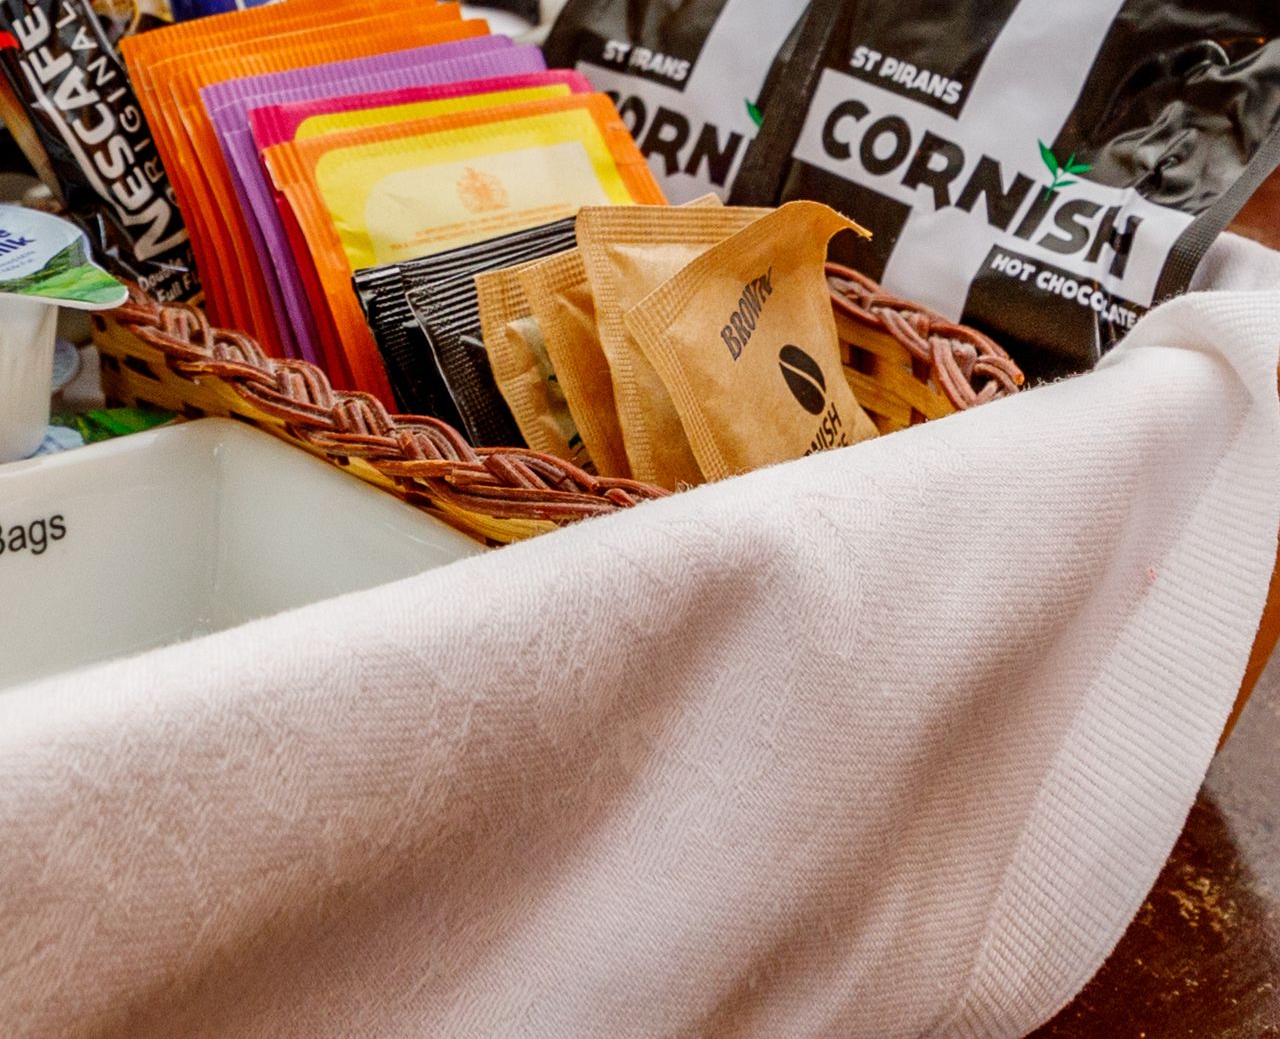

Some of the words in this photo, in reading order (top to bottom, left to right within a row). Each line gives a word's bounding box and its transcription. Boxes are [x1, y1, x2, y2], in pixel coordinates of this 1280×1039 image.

[602, 39, 631, 63] ST
[849, 46, 882, 72] ST
[878, 56, 964, 106] PIRANS
[606, 91, 744, 189] ORN
[821, 98, 1145, 280] CORNISH
[720, 266, 774, 361] BROWN
[990, 253, 1038, 283] HOT
[1035, 269, 1139, 329] CHOCOLATE
[803, 401, 843, 457] NISH
